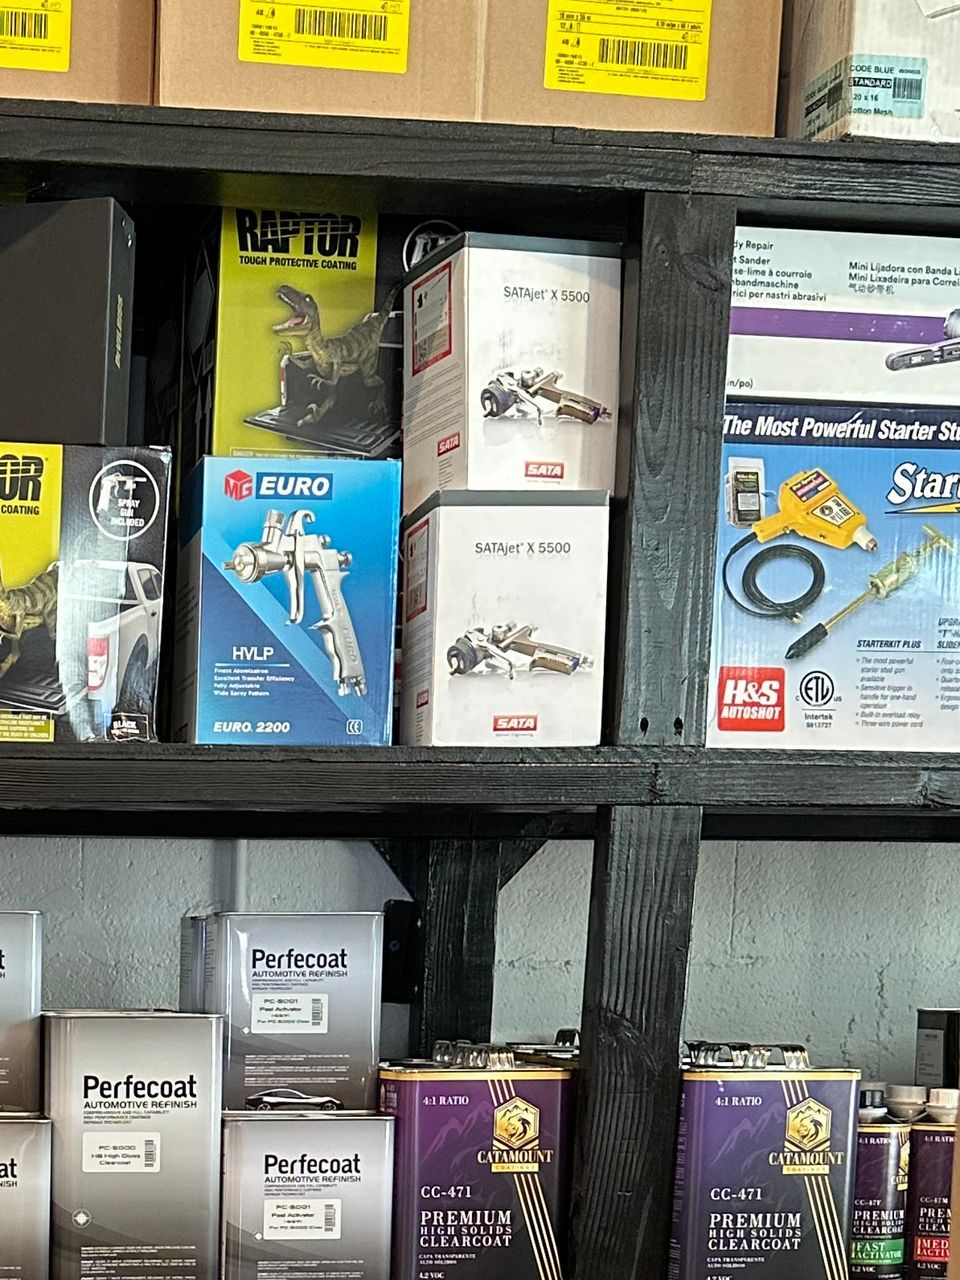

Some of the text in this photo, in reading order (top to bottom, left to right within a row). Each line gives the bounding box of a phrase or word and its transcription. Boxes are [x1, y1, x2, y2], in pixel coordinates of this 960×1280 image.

[874, 66, 894, 74] BLUE
[236, 209, 362, 257] RAPTOR
[239, 256, 357, 270] TOUGH PROTECTIVE COATING
[849, 262, 952, 275] Mini Lijadora con Banda
[551, 290, 558, 299] X
[561, 291, 590, 302] 5500
[723, 416, 752, 435] The
[755, 417, 796, 436] Most
[801, 419, 876, 438] Powerful
[878, 421, 936, 440] Starter
[528, 464, 562, 476] SATA
[259, 477, 330, 495] EURO
[111, 518, 145, 527] INCLUDED
[528, 543, 534, 553] X
[538, 543, 571, 554] 5500
[857, 640, 921, 648] STARTERKIT PLUS
[723, 679, 780, 705] H&S
[720, 706, 781, 720] AUTOSHOT
[804, 712, 833, 721] Intertek
[496, 718, 535, 729] SATA
[84, 1100, 197, 1109] AUTOMOTIVE REFINISH
[423, 1096, 469, 1105] 4:1 RATIO
[715, 1096, 762, 1106] 4:1 RATIO
[421, 1185, 471, 1198] CC-471
[710, 1188, 762, 1200] CC-471
[420, 1210, 512, 1226] PREMIUM
[710, 1213, 802, 1228] PREMIUM
[420, 1226, 512, 1235] HIGH SOLIDS
[709, 1228, 802, 1238] HIGH SOLIDS
[420, 1235, 512, 1247] CLEARCOAT
[708, 1238, 801, 1250] CLEARCOAT
[856, 1242, 886, 1252] FAST
